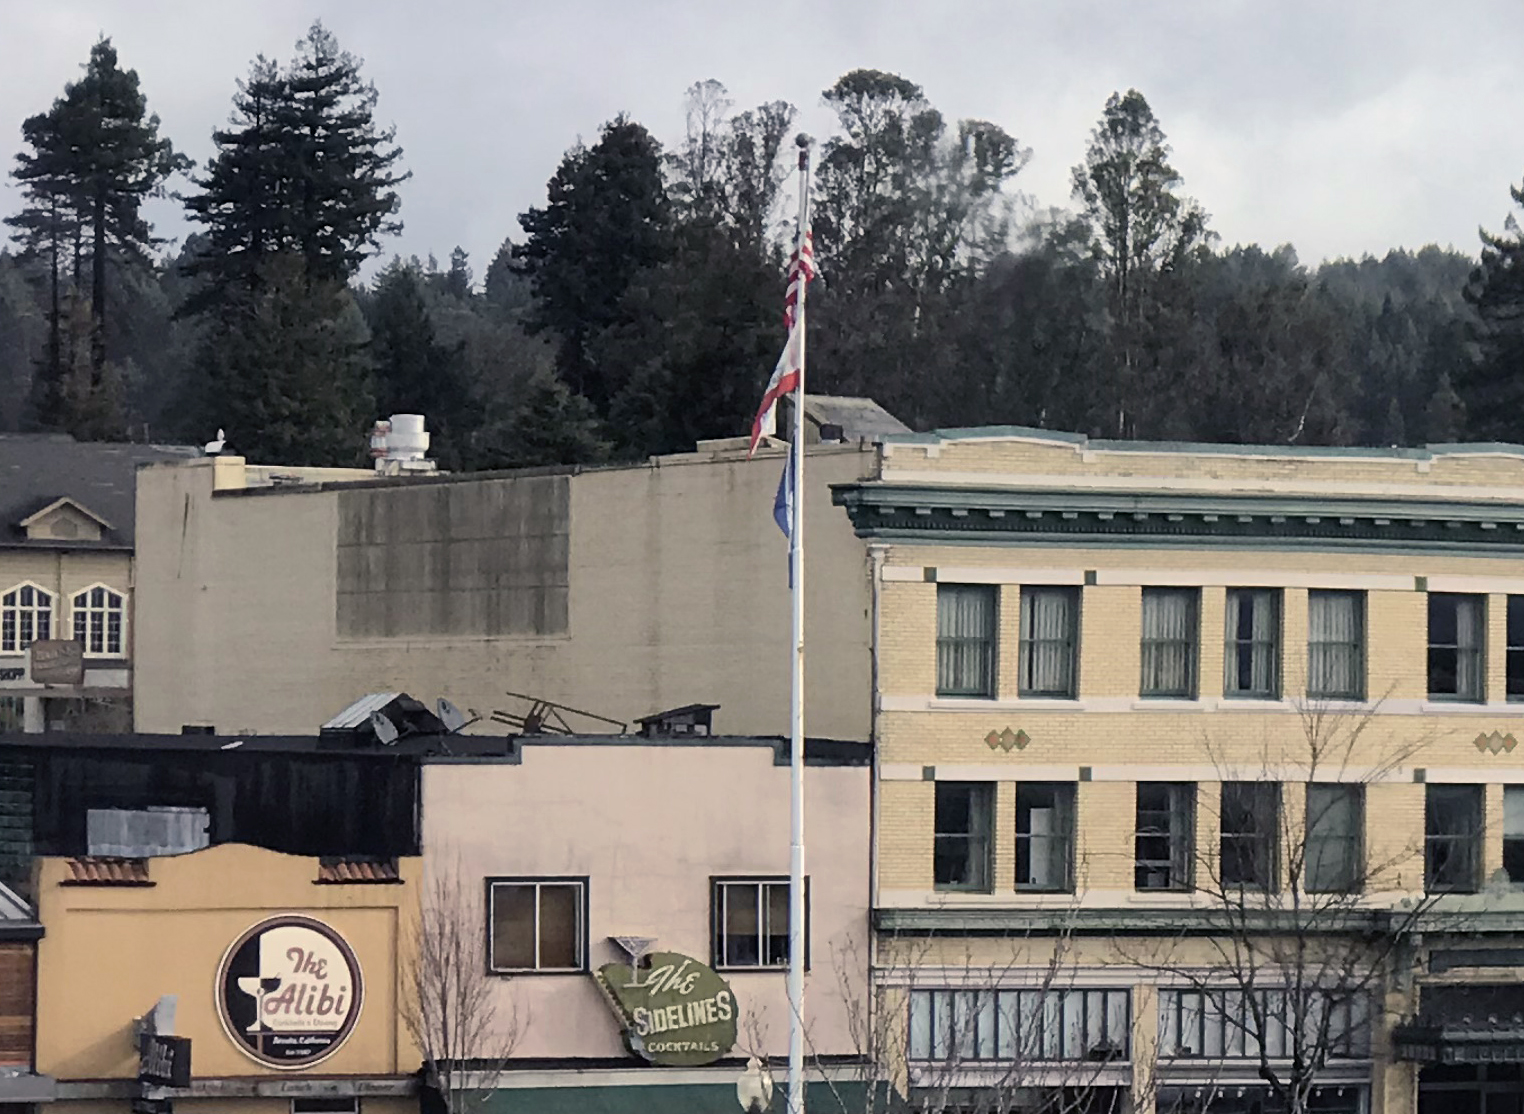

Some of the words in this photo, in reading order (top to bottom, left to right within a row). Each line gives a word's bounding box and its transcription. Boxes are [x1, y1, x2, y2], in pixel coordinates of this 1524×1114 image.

[286, 947, 328, 980] The
[644, 959, 701, 997] The
[263, 983, 347, 1015] Alibi
[633, 990, 732, 1036] SIDELINES
[648, 1041, 719, 1053] COCKTAILS
